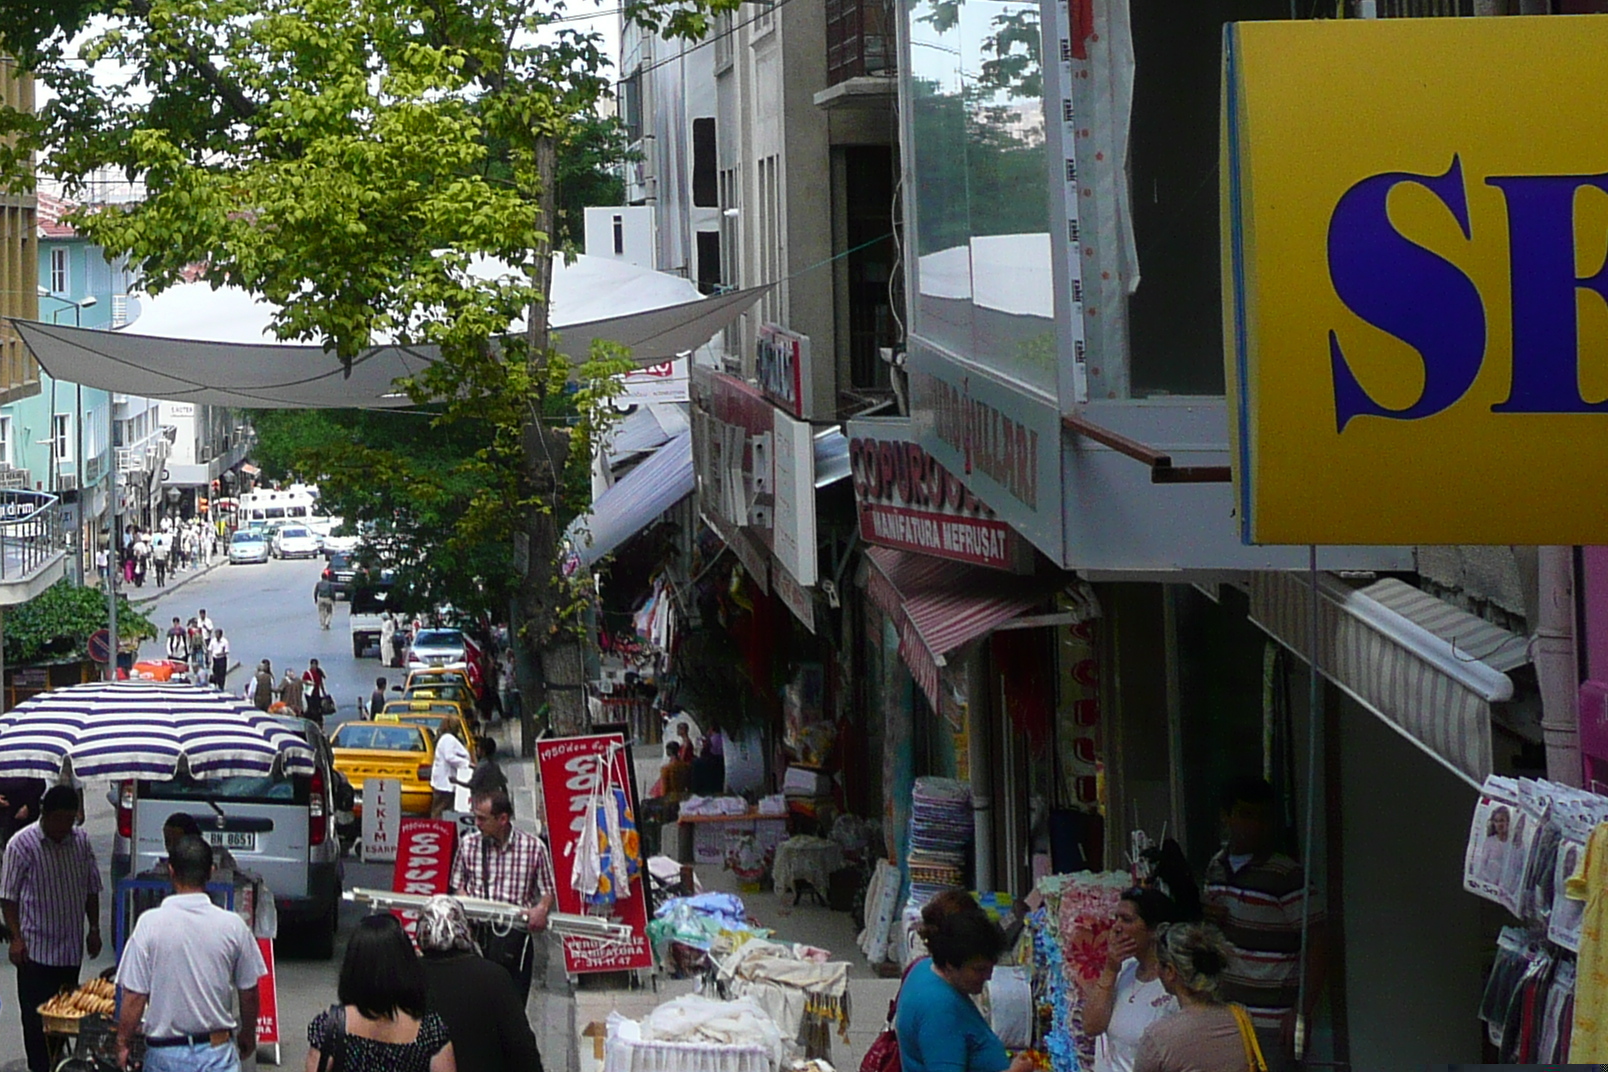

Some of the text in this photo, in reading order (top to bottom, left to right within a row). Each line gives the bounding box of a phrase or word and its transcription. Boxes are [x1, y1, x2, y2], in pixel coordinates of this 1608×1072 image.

[871, 508, 1007, 562] MANİFATURA MEFRUŞAT
[373, 779, 388, 843] İLKİM
[227, 832, 252, 847] 8651
